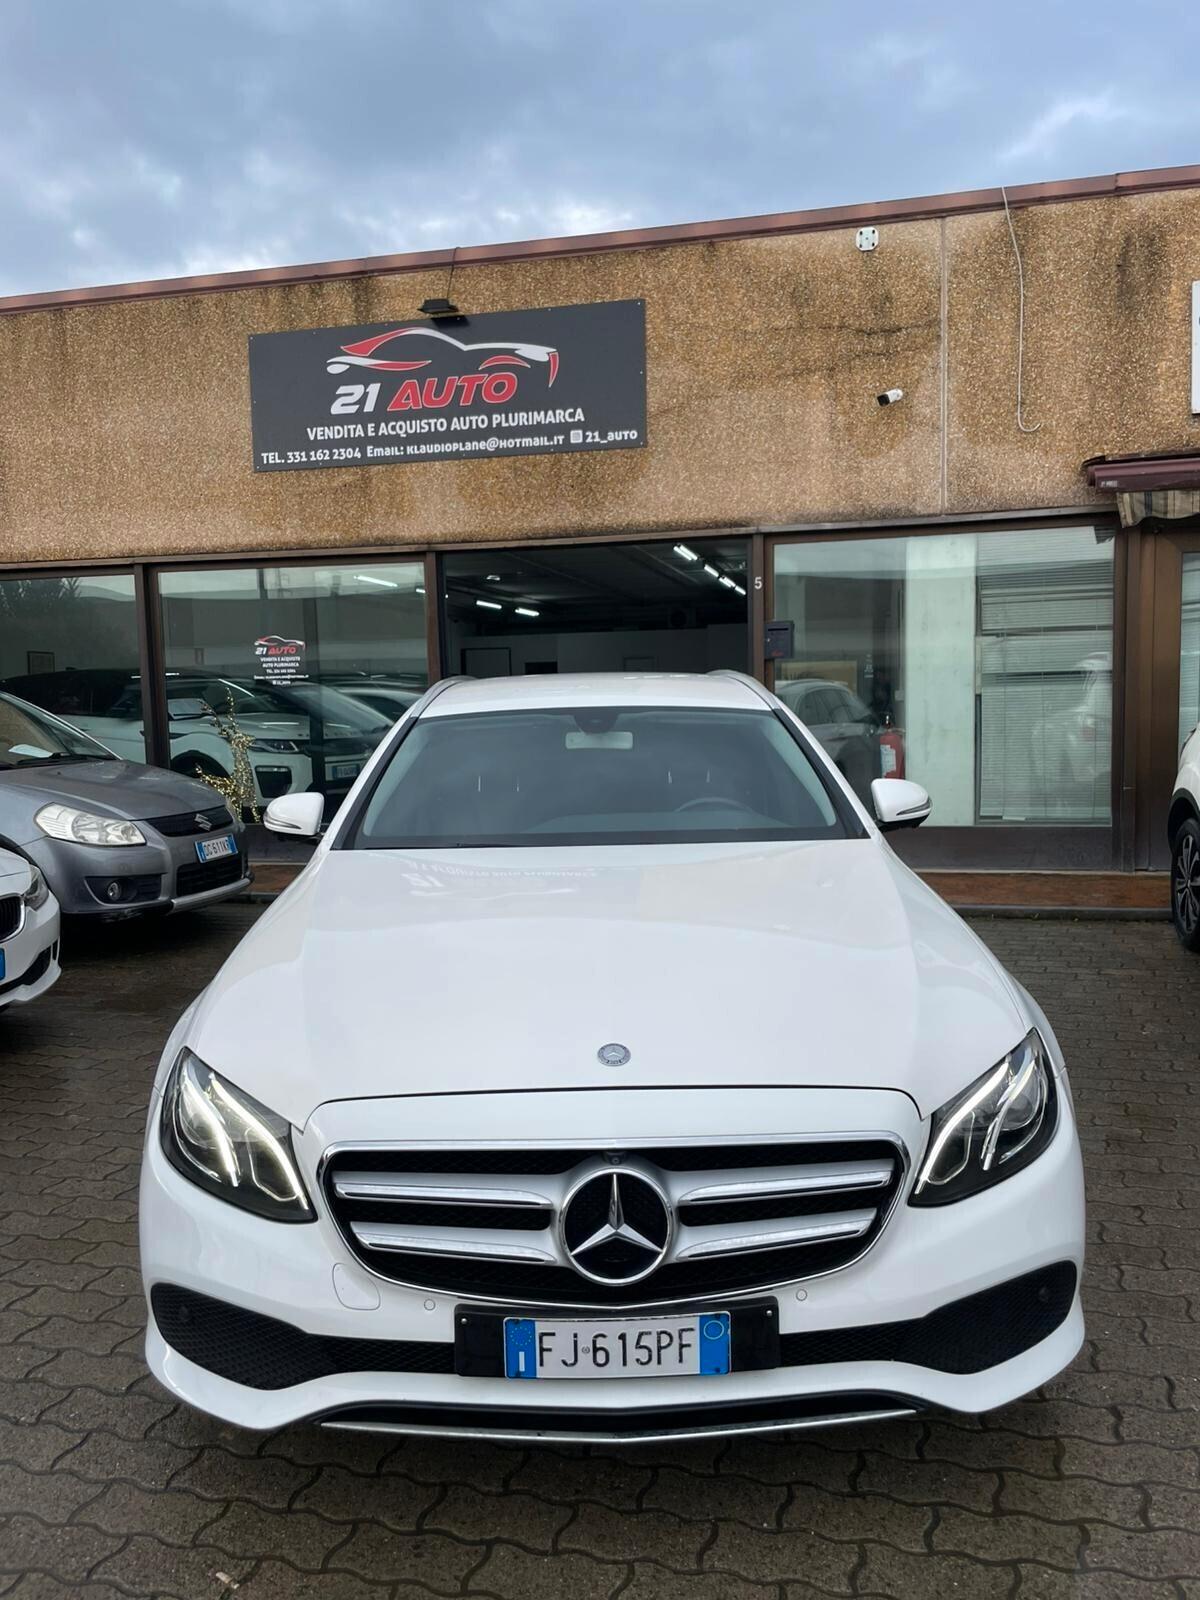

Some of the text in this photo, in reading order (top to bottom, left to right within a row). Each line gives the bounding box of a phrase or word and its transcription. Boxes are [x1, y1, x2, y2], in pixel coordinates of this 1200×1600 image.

[330, 372, 518, 414] 21 AUTO
[307, 408, 585, 440] VENDITA E ACQUISTO AUTO PLURIMARCA
[261, 452, 285, 464] TEL.
[287, 451, 307, 463] 331
[309, 450, 330, 461] 162
[333, 448, 361, 459] 2304
[754, 577, 763, 589] 5
[255, 646, 297, 655] 21 AUTO
